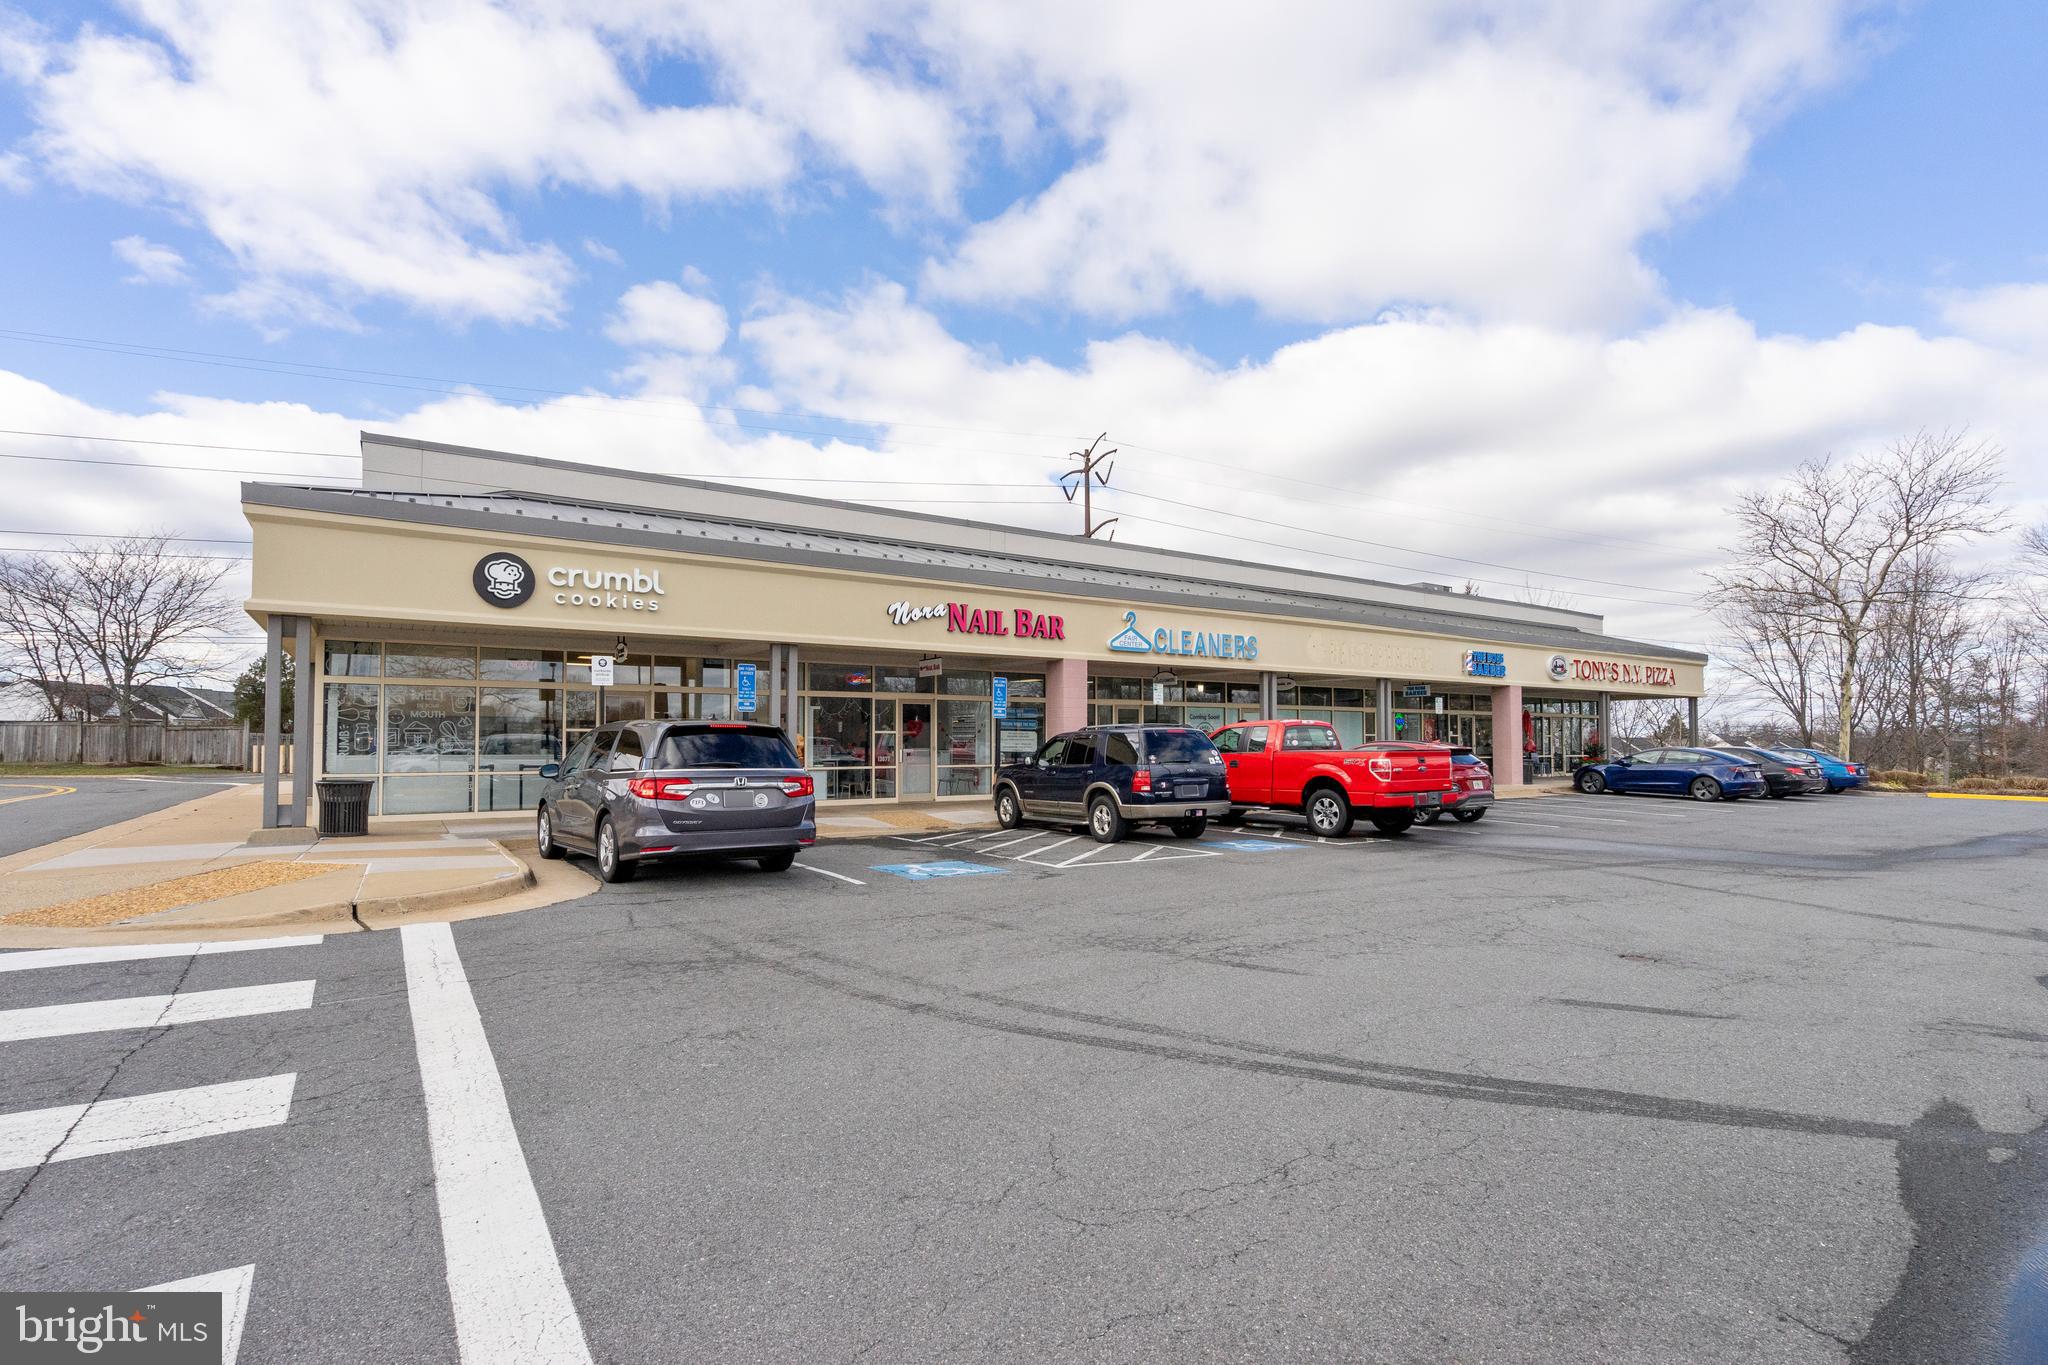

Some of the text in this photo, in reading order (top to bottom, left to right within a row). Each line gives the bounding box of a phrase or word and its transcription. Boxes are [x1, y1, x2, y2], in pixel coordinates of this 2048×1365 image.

[548, 566, 665, 595] crumbl
[554, 591, 659, 611] cookies
[888, 601, 1065, 639] Nora NAIL BAR
[1119, 640, 1143, 648] CENTER
[1123, 634, 1138, 642] FAIR
[1153, 627, 1258, 660] CLEANERS
[1472, 651, 1487, 663] THE
[1471, 663, 1506, 677] BARBER
[1573, 659, 1619, 681] TONY'S
[1645, 666, 1677, 686] PIZZA
[410, 711, 446, 719] MOUTH
